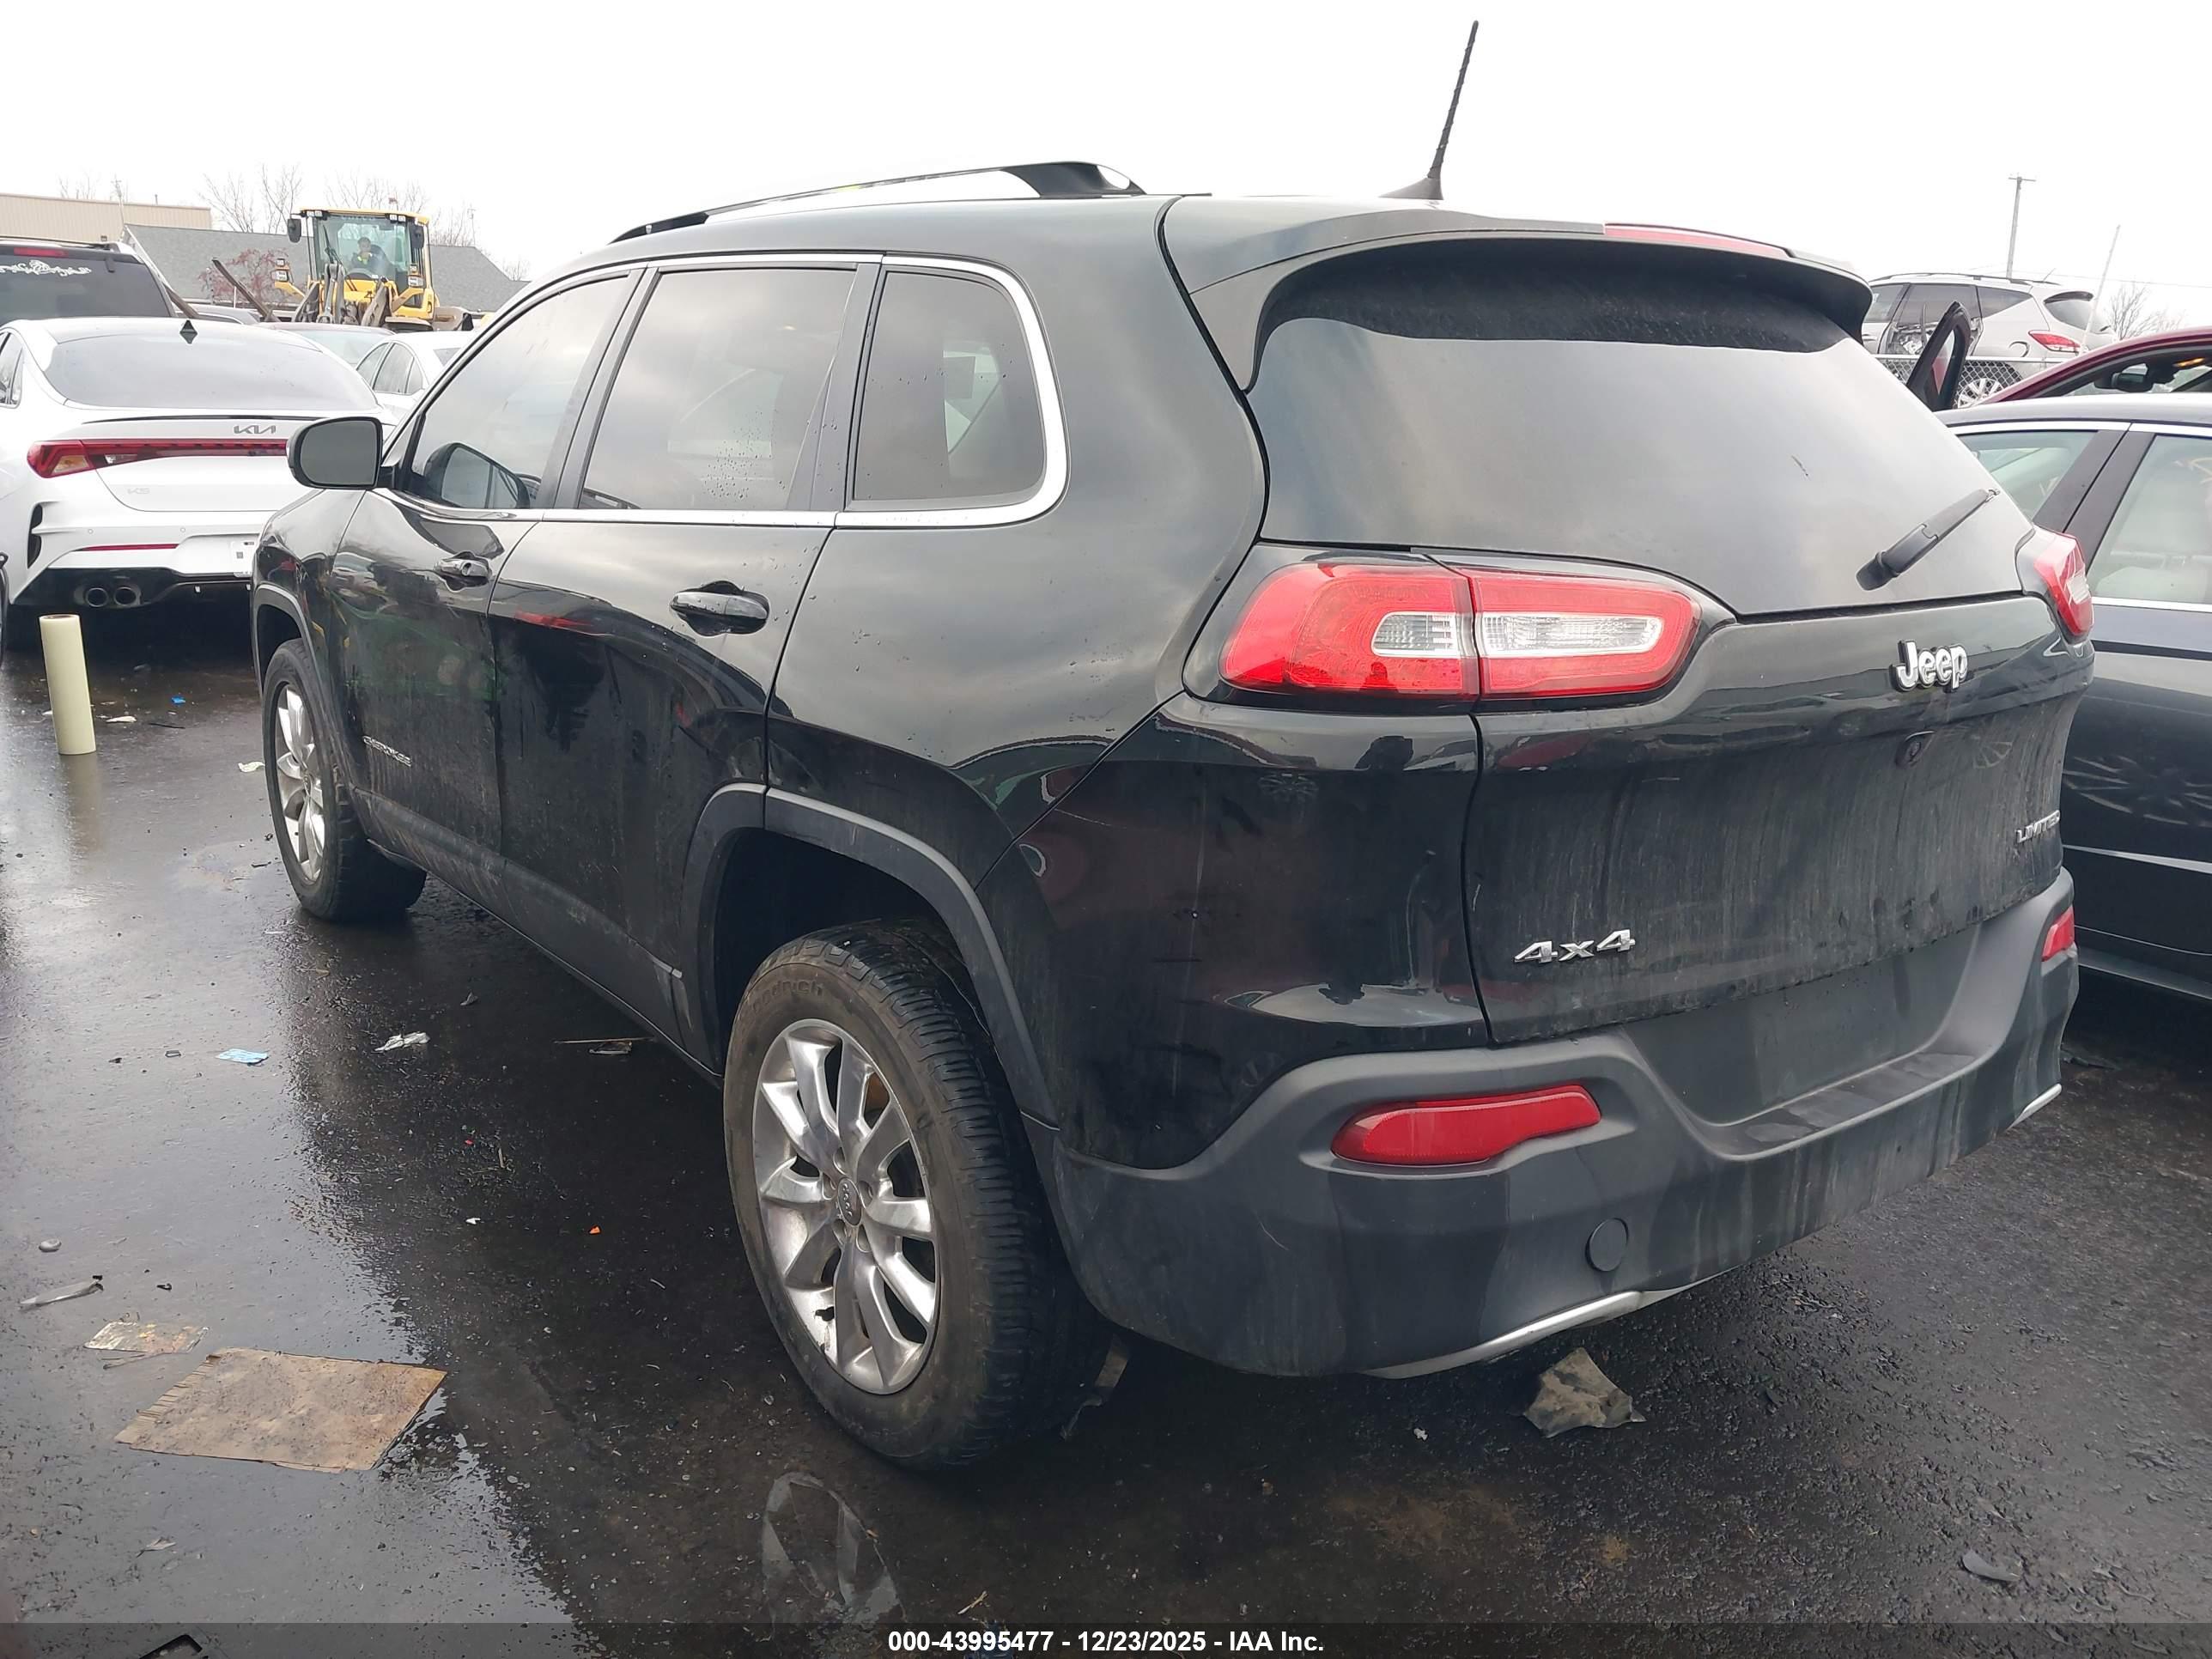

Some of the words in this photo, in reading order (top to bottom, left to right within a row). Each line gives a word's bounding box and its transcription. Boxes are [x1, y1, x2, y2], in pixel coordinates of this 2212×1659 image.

[234, 424, 276, 434] KIA
[1892, 639, 1968, 690] Jeep
[2014, 809, 2061, 844] LIMITED
